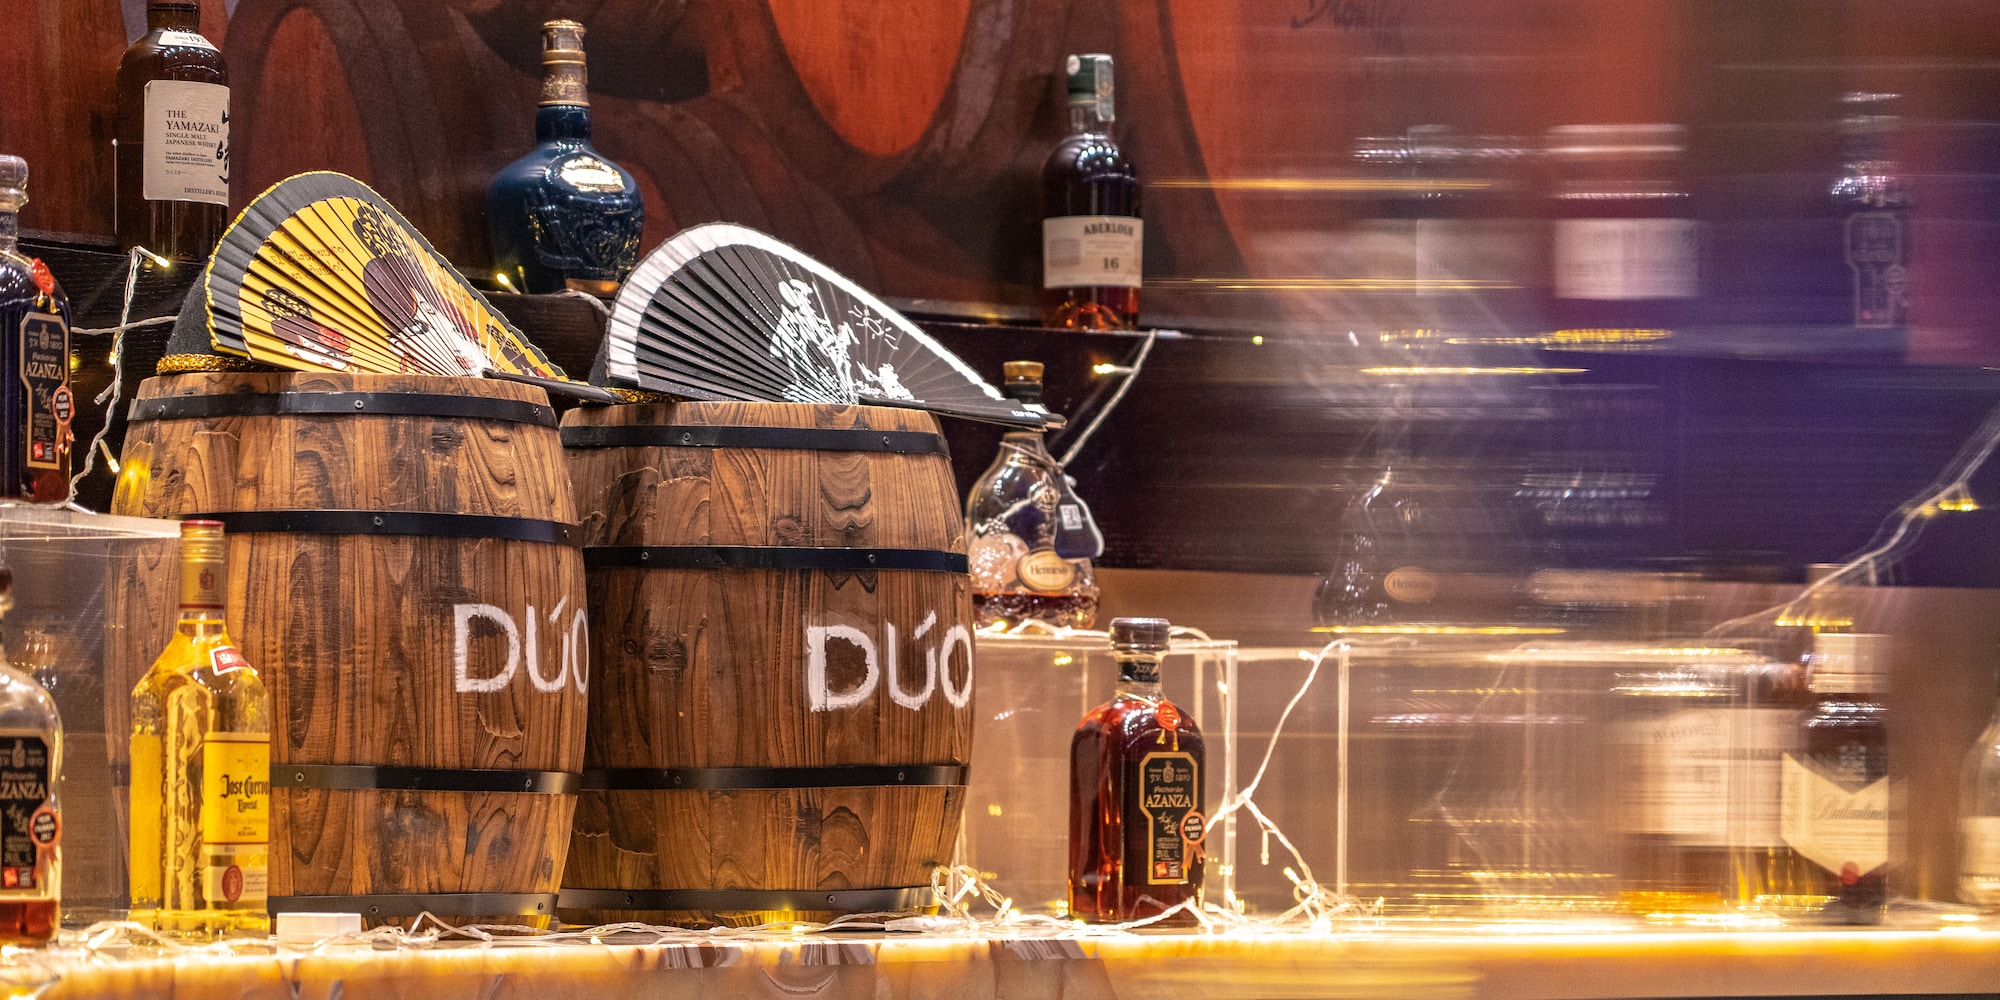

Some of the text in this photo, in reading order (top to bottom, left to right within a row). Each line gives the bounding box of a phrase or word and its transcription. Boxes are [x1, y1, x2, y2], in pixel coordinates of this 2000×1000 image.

[166, 110, 187, 119] THE
[166, 120, 219, 134] YAMAZAKI
[165, 139, 197, 147] JAPANESE
[1103, 257, 1120, 270] 16
[25, 361, 64, 380] AZANZA
[1145, 794, 1192, 808] AZANZA
